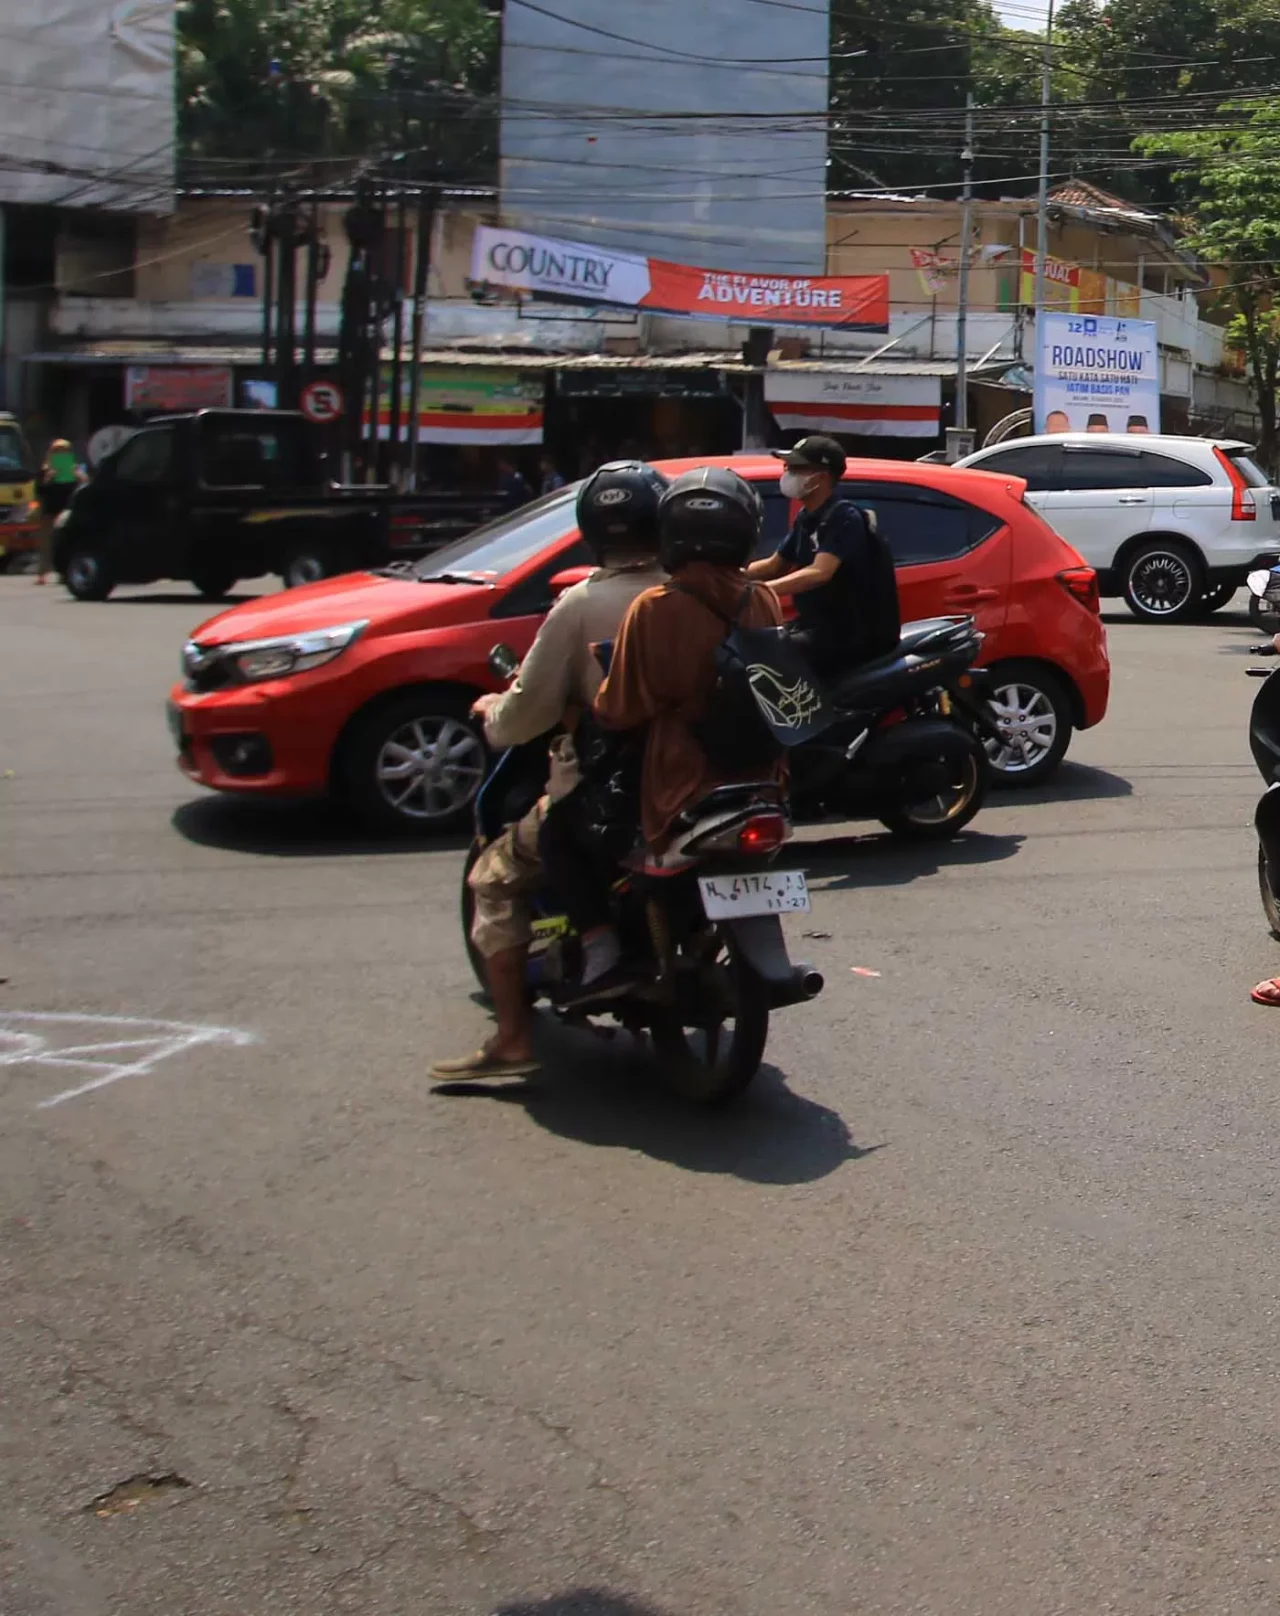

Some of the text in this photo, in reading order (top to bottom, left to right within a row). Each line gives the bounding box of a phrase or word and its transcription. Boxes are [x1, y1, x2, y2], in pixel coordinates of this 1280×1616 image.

[491, 243, 614, 286] COUNTRY
[698, 283, 842, 308] ADVENTURE
[792, 279, 812, 289] OF
[1052, 345, 1142, 370] ROADSHOW
